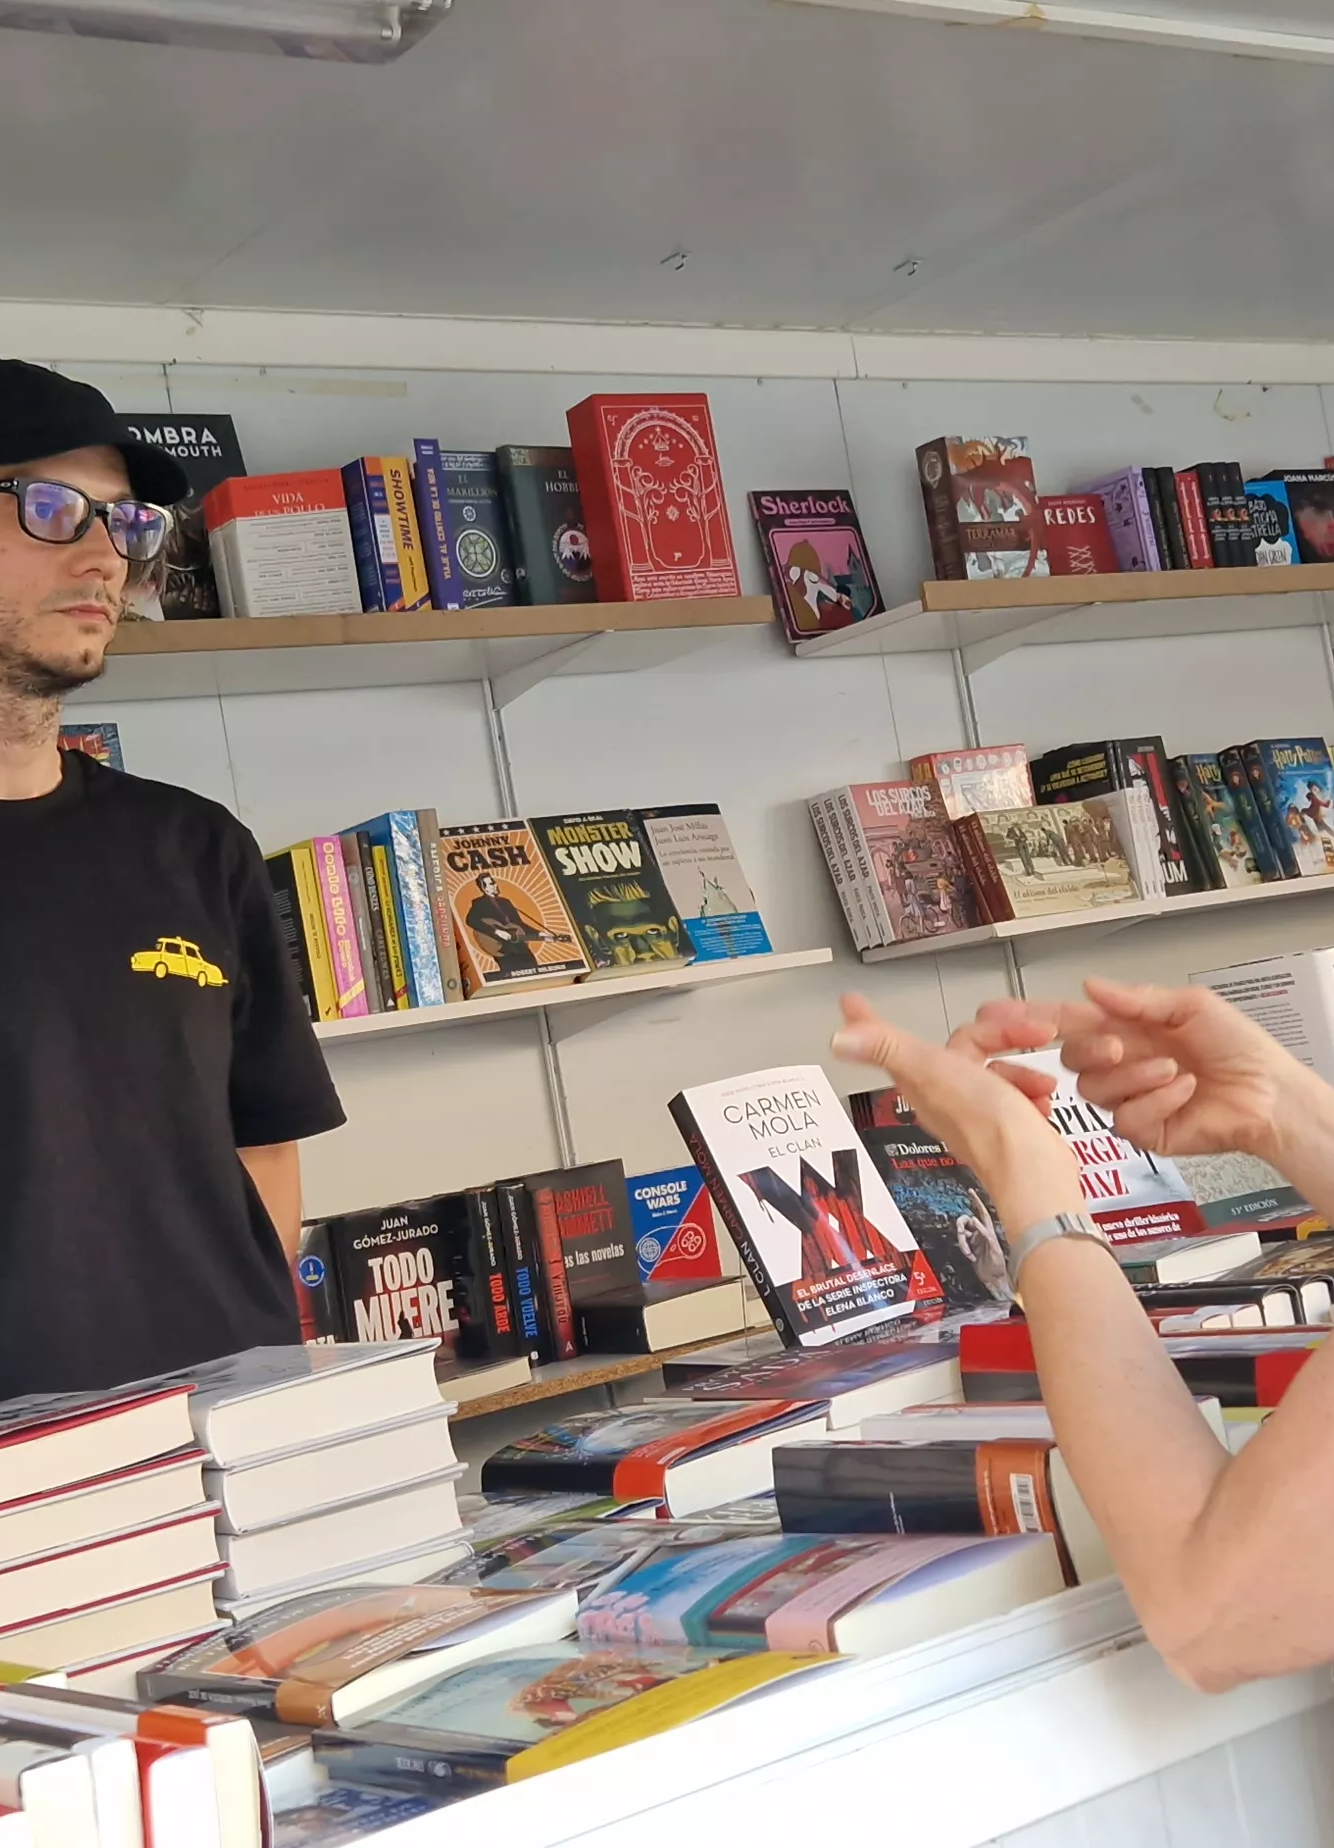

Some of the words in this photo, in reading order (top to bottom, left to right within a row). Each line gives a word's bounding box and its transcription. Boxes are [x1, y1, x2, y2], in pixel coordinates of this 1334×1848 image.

[544, 480, 579, 493] HOBBI
[557, 469, 569, 480] EL
[1283, 473, 1308, 483] JOANA
[271, 491, 304, 505] VIDA
[446, 486, 498, 498] MARILLION
[389, 468, 415, 556] SHOWTIME
[760, 494, 851, 516] Sherlock
[1044, 505, 1097, 526] REDES
[1272, 747, 1298, 770] Harry
[1195, 763, 1221, 784] Harry
[838, 794, 847, 810] LOS
[866, 788, 887, 806] LOS
[888, 785, 931, 802] SURCOS
[875, 803, 899, 817] DEL
[898, 800, 927, 815] AZAR
[547, 821, 634, 846] MONSTER
[650, 825, 669, 835] Juan
[668, 823, 685, 833] José
[843, 809, 857, 842] SURCOS
[453, 835, 510, 850] JOHNNY
[654, 836, 673, 846] Juan
[811, 802, 820, 818] LOS
[816, 819, 832, 852] SURCOS
[826, 848, 835, 864] DEL
[831, 864, 843, 886] AZAR
[823, 798, 833, 813] LOS
[829, 814, 844, 846] SURCOS
[838, 844, 849, 860] DEL
[844, 860, 857, 883] AZAR
[852, 839, 863, 855] DEL
[446, 845, 532, 873] CASH
[555, 840, 643, 876] SHOW
[857, 855, 871, 880] AZAR
[723, 1088, 821, 1125] CARMEN
[1048, 1095, 1109, 1136] SPÍA
[749, 1111, 819, 1141] MOLA
[689, 1132, 714, 1176] MOLA
[767, 1145, 785, 1158] EL
[786, 1137, 823, 1155] CLAN
[897, 1142, 942, 1156] Dolores
[917, 1159, 938, 1170] que
[634, 1180, 688, 1201] CONSOLE
[646, 1194, 681, 1211] WARS
[709, 1176, 745, 1242] CARMEN
[1244, 1198, 1278, 1214] EDICIÓN
[380, 1214, 409, 1231] JUAN
[353, 1223, 439, 1250] GÓMEZ-JURADO
[576, 1252, 590, 1266] las
[591, 1242, 625, 1262] novelas
[740, 1241, 766, 1284] CLAN
[367, 1247, 435, 1294] TODO
[516, 1266, 532, 1296] TODO
[796, 1288, 809, 1299] EL
[809, 1278, 847, 1295] BRUTAL
[846, 1262, 898, 1283] DESENLACE
[489, 1272, 505, 1307] TODO
[797, 1300, 813, 1312] DE
[812, 1296, 826, 1308] LA
[825, 1286, 852, 1304] SERIE
[852, 1273, 908, 1295] INSPECTORA
[353, 1279, 460, 1343] MUERE
[825, 1302, 856, 1317] ELENA
[856, 1288, 895, 1309] BLANCO
[494, 1302, 511, 1334] ARDE
[519, 1297, 539, 1338] VUELVE
